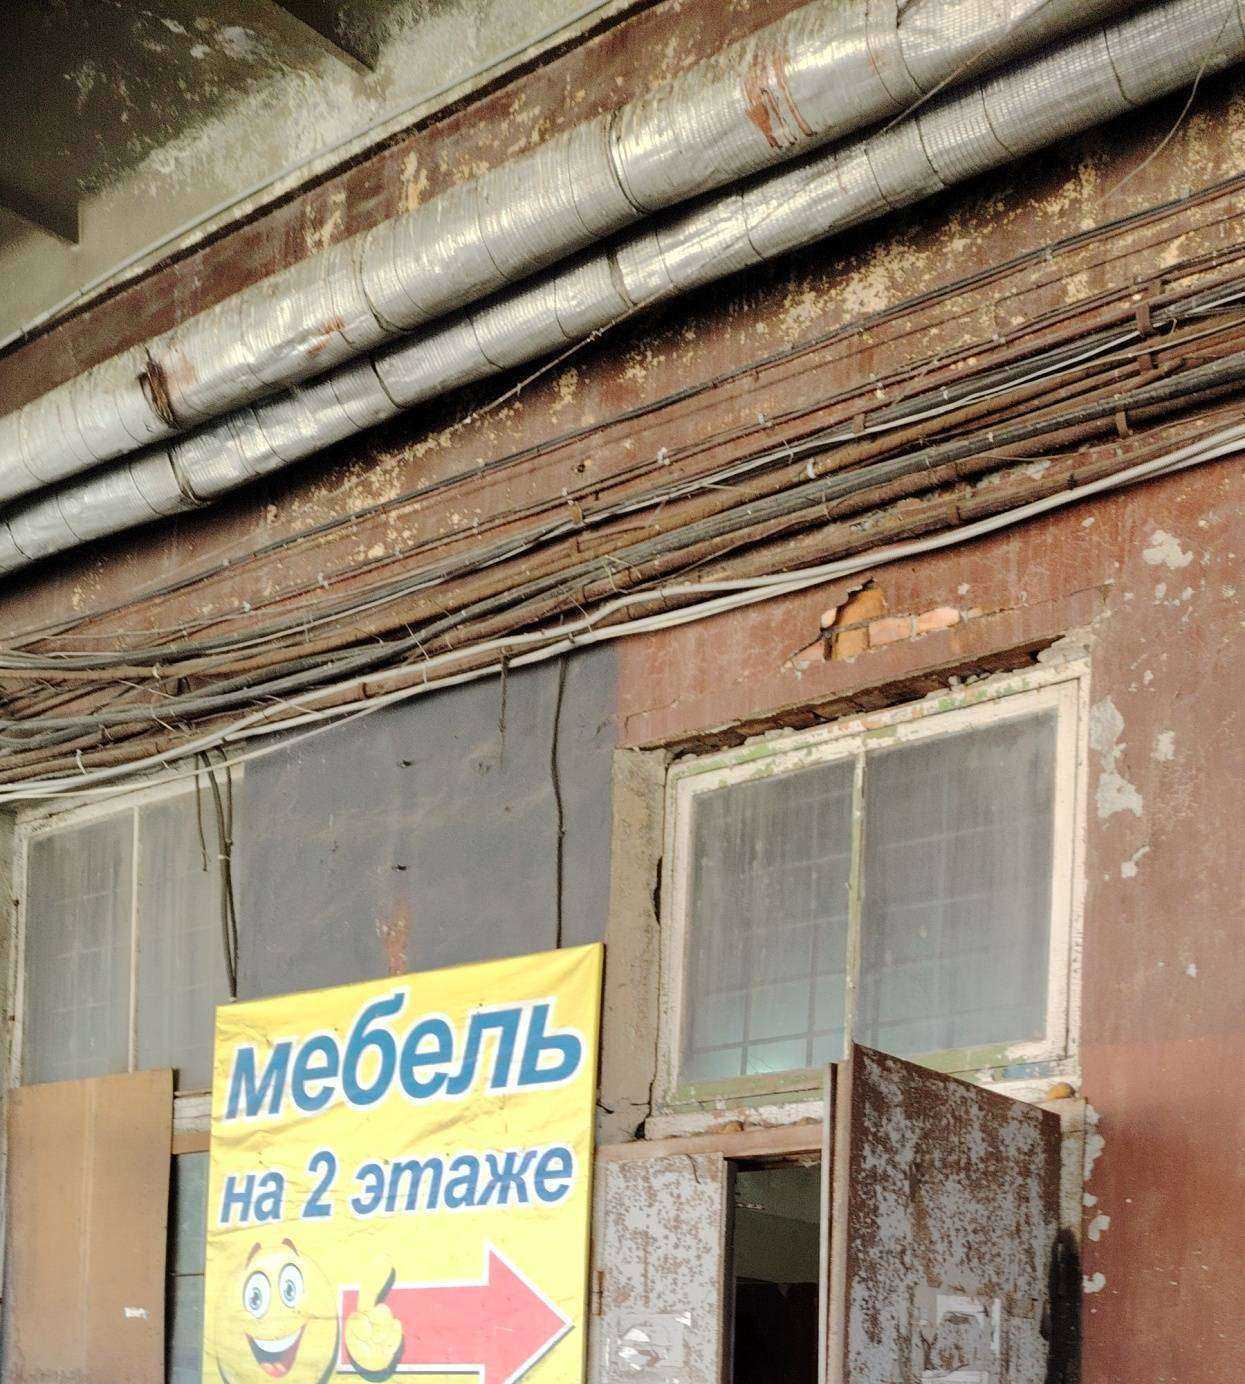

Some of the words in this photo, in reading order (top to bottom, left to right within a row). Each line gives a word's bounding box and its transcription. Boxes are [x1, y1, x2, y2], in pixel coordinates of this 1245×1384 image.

[225, 992, 582, 1119] мебель
[220, 1170, 285, 1223] на
[302, 1150, 337, 1218] 2
[351, 1145, 574, 1215] этаже
